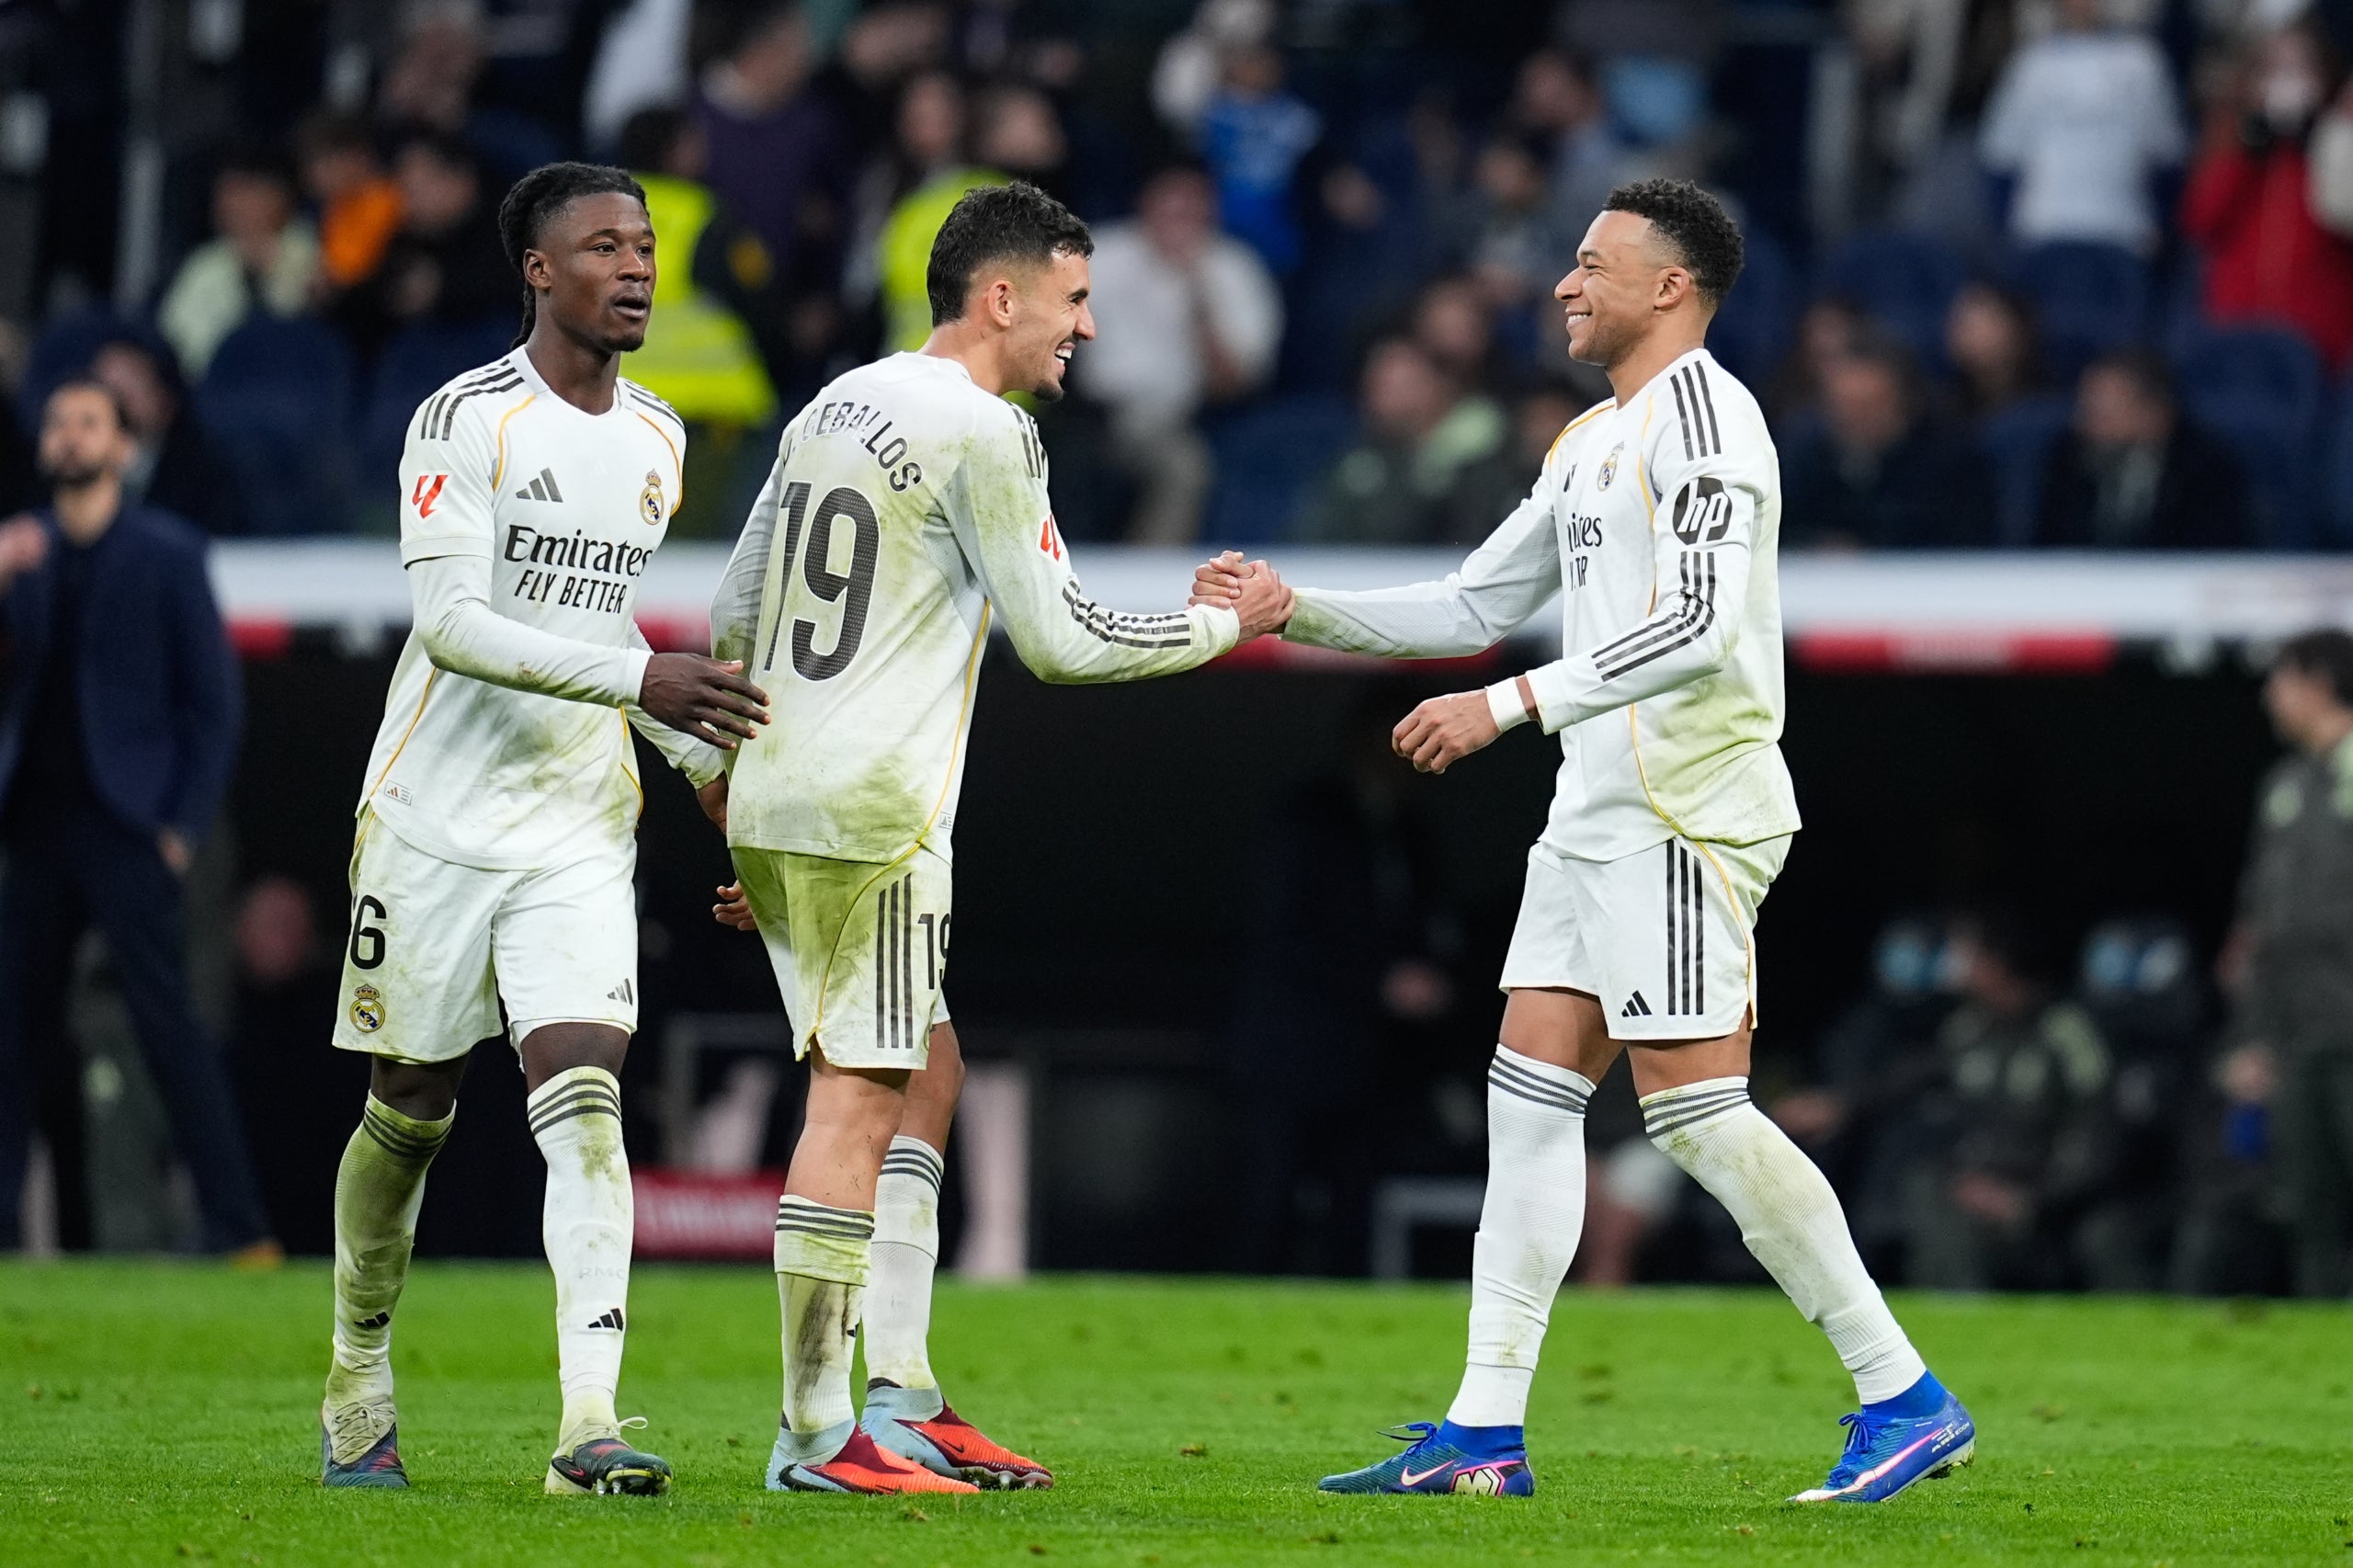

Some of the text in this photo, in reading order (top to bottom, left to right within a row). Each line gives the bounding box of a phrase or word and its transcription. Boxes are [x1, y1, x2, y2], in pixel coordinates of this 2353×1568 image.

[1674, 477, 1732, 545] hp
[505, 525, 654, 576] Emirates
[763, 481, 881, 682] 19
[514, 569, 628, 614] FLY BETTER
[349, 894, 387, 970] 6
